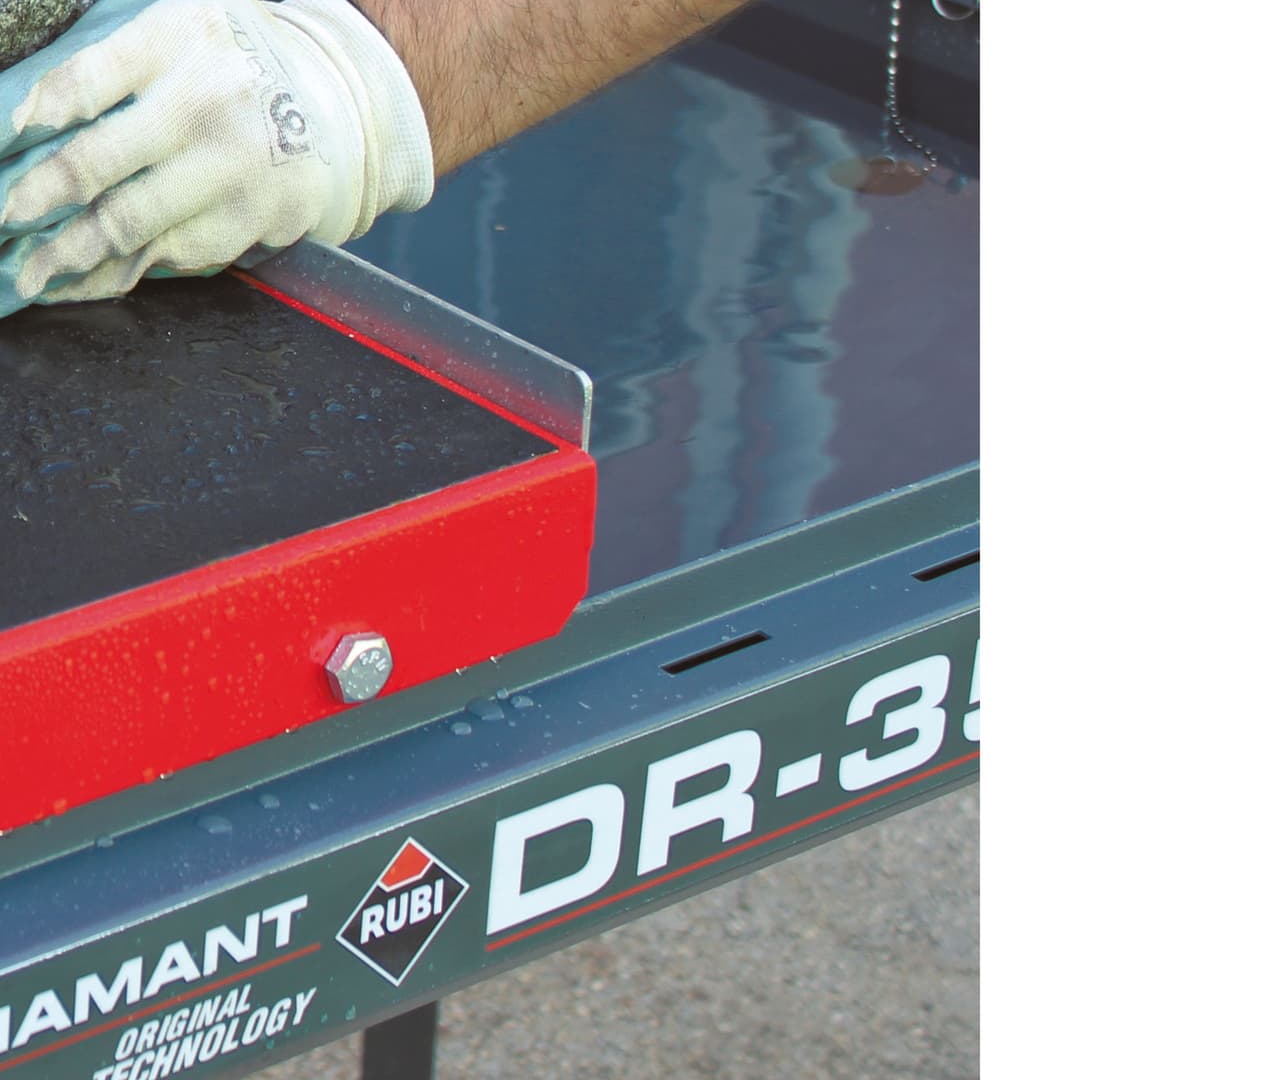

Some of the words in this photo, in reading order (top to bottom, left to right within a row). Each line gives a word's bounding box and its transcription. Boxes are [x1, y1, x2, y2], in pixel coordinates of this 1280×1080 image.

[486, 640, 981, 937] DR-3
[360, 879, 443, 944] RUBI
[114, 983, 252, 1061] ORIGINAL
